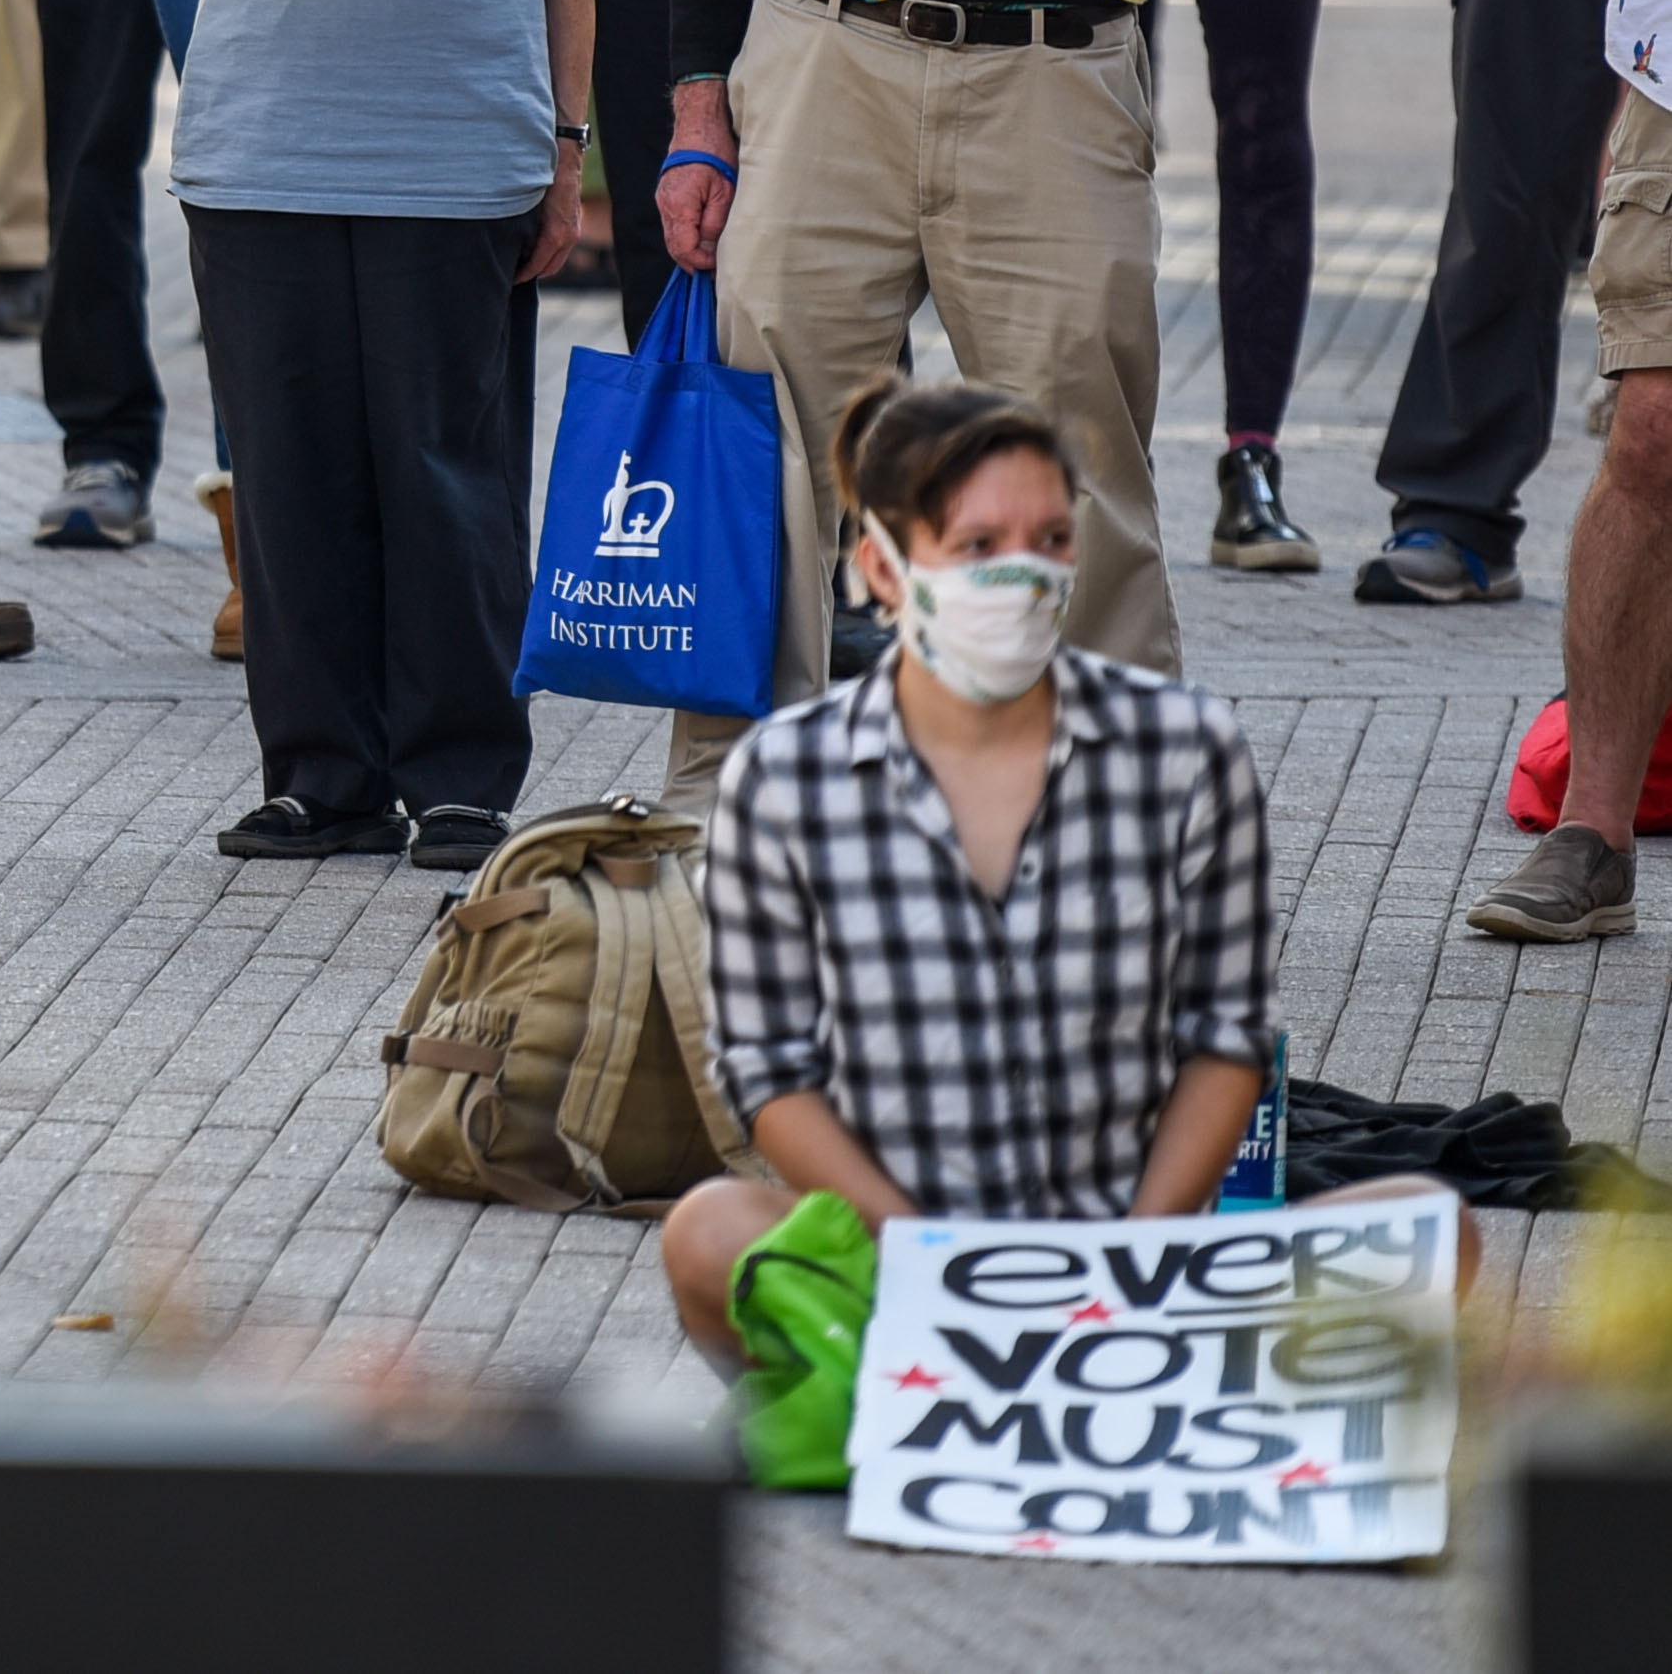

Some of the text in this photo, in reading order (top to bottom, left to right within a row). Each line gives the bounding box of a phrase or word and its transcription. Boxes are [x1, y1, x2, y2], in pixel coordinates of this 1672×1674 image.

[551, 568, 696, 608] HARRIMAN
[550, 611, 693, 652] INSTITUTE
[893, 1398, 1402, 1472] MUST
[901, 1475, 1439, 1546] COUNT
